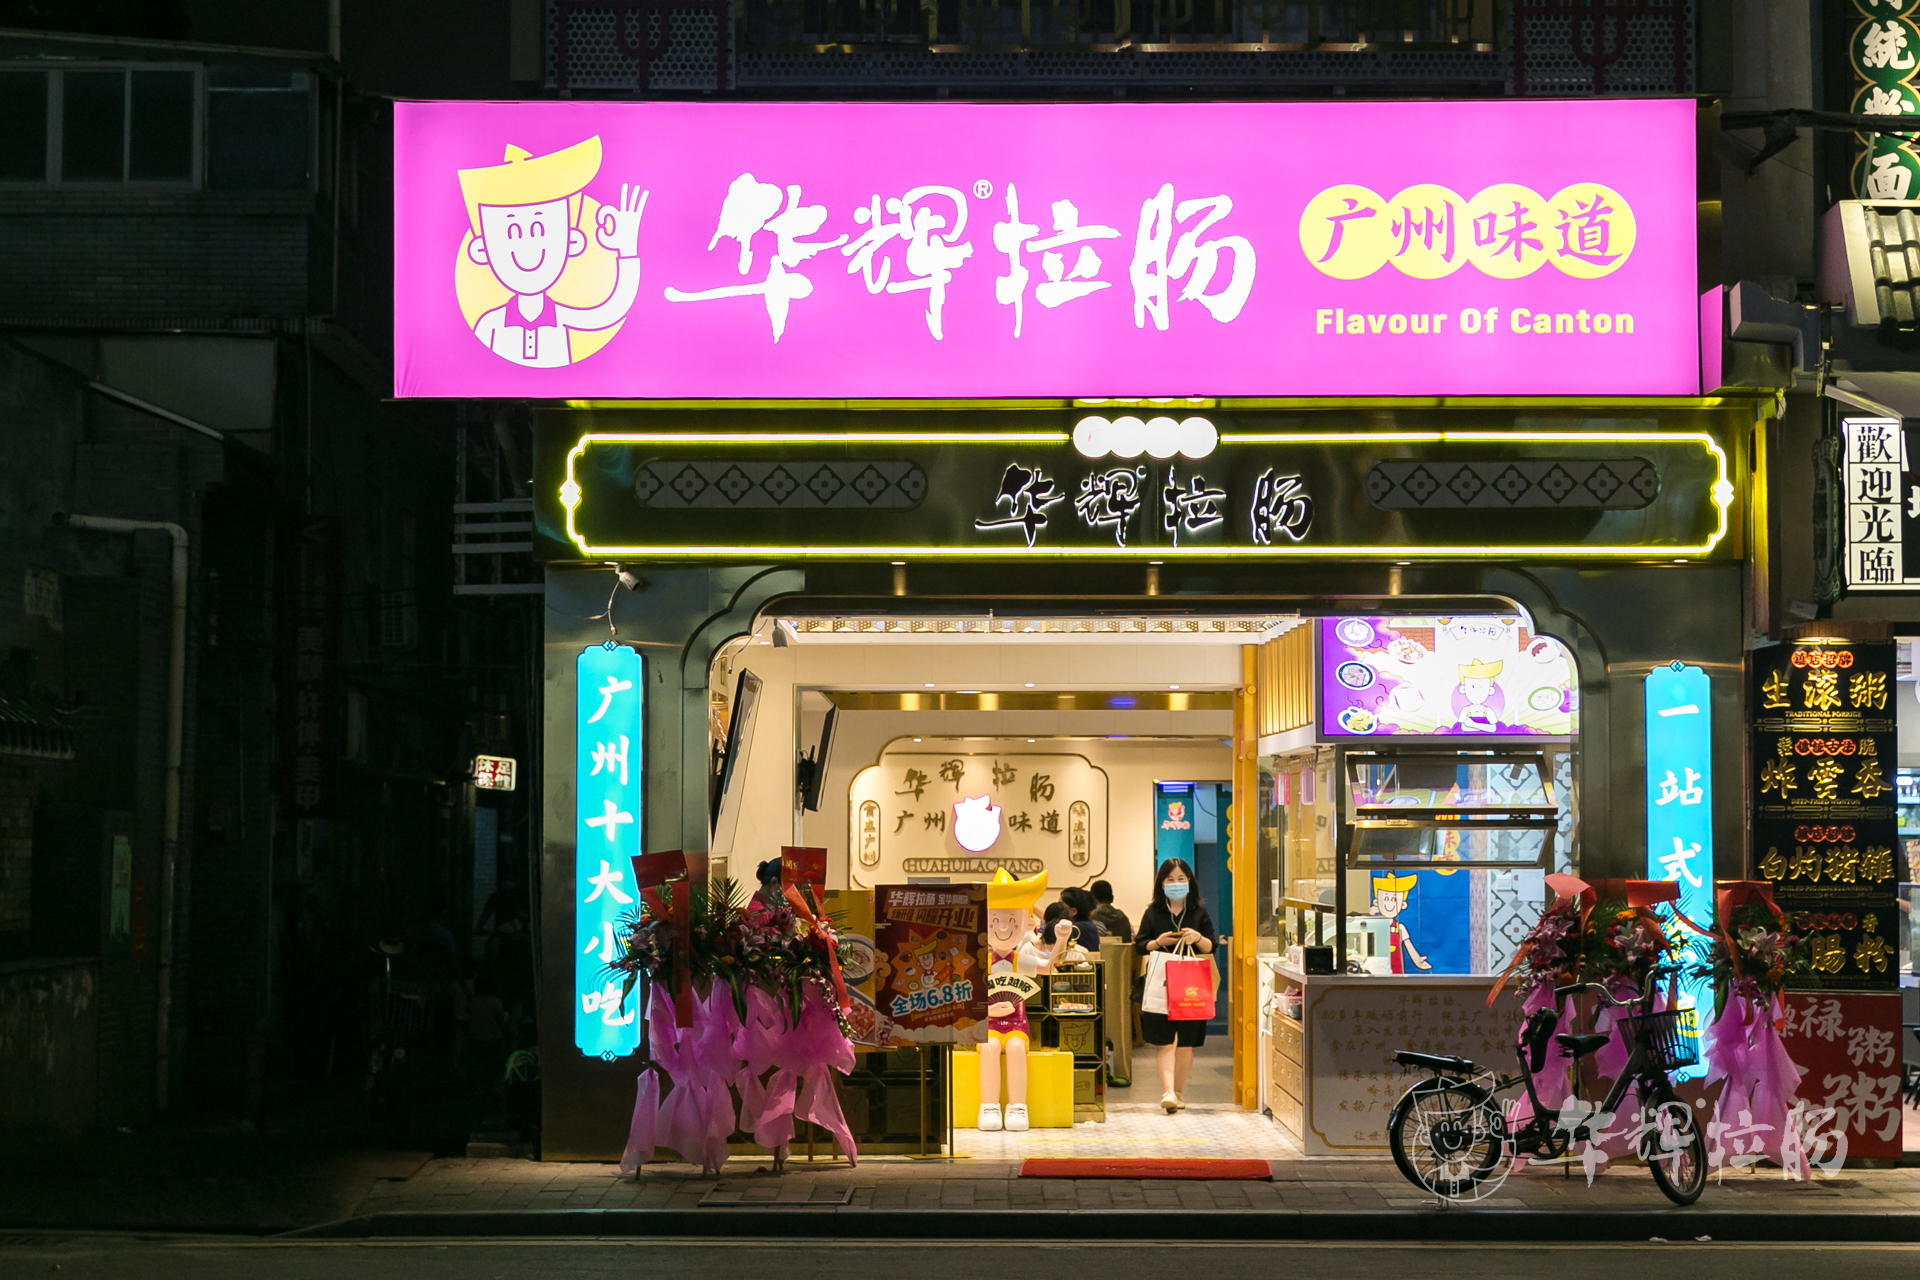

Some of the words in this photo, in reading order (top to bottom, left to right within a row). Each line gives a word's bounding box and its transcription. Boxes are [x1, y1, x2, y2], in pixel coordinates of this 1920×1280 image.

[1317, 192, 1625, 267] 广州味道
[664, 173, 1257, 345] 华辉拉肠
[1316, 307, 1447, 335] Flavour
[1459, 307, 1499, 334] Of
[1510, 307, 1635, 335] Canton
[974, 463, 1314, 548] 华辉拉肠
[1856, 426, 1896, 584] 歡迎光臨
[1784, 710, 1830, 719] TRADITIONAL
[894, 758, 1056, 803] 华辉拉肠
[893, 810, 946, 834] 广州
[1008, 810, 1063, 834] 味道
[580, 675, 635, 1028] 广州十大小吃
[905, 858, 1042, 874] HUAHUILACHANG
[887, 891, 936, 907] 华辉拉肠
[1785, 933, 1895, 975] 腸粉
[890, 979, 973, 1017] 全场6.8折
